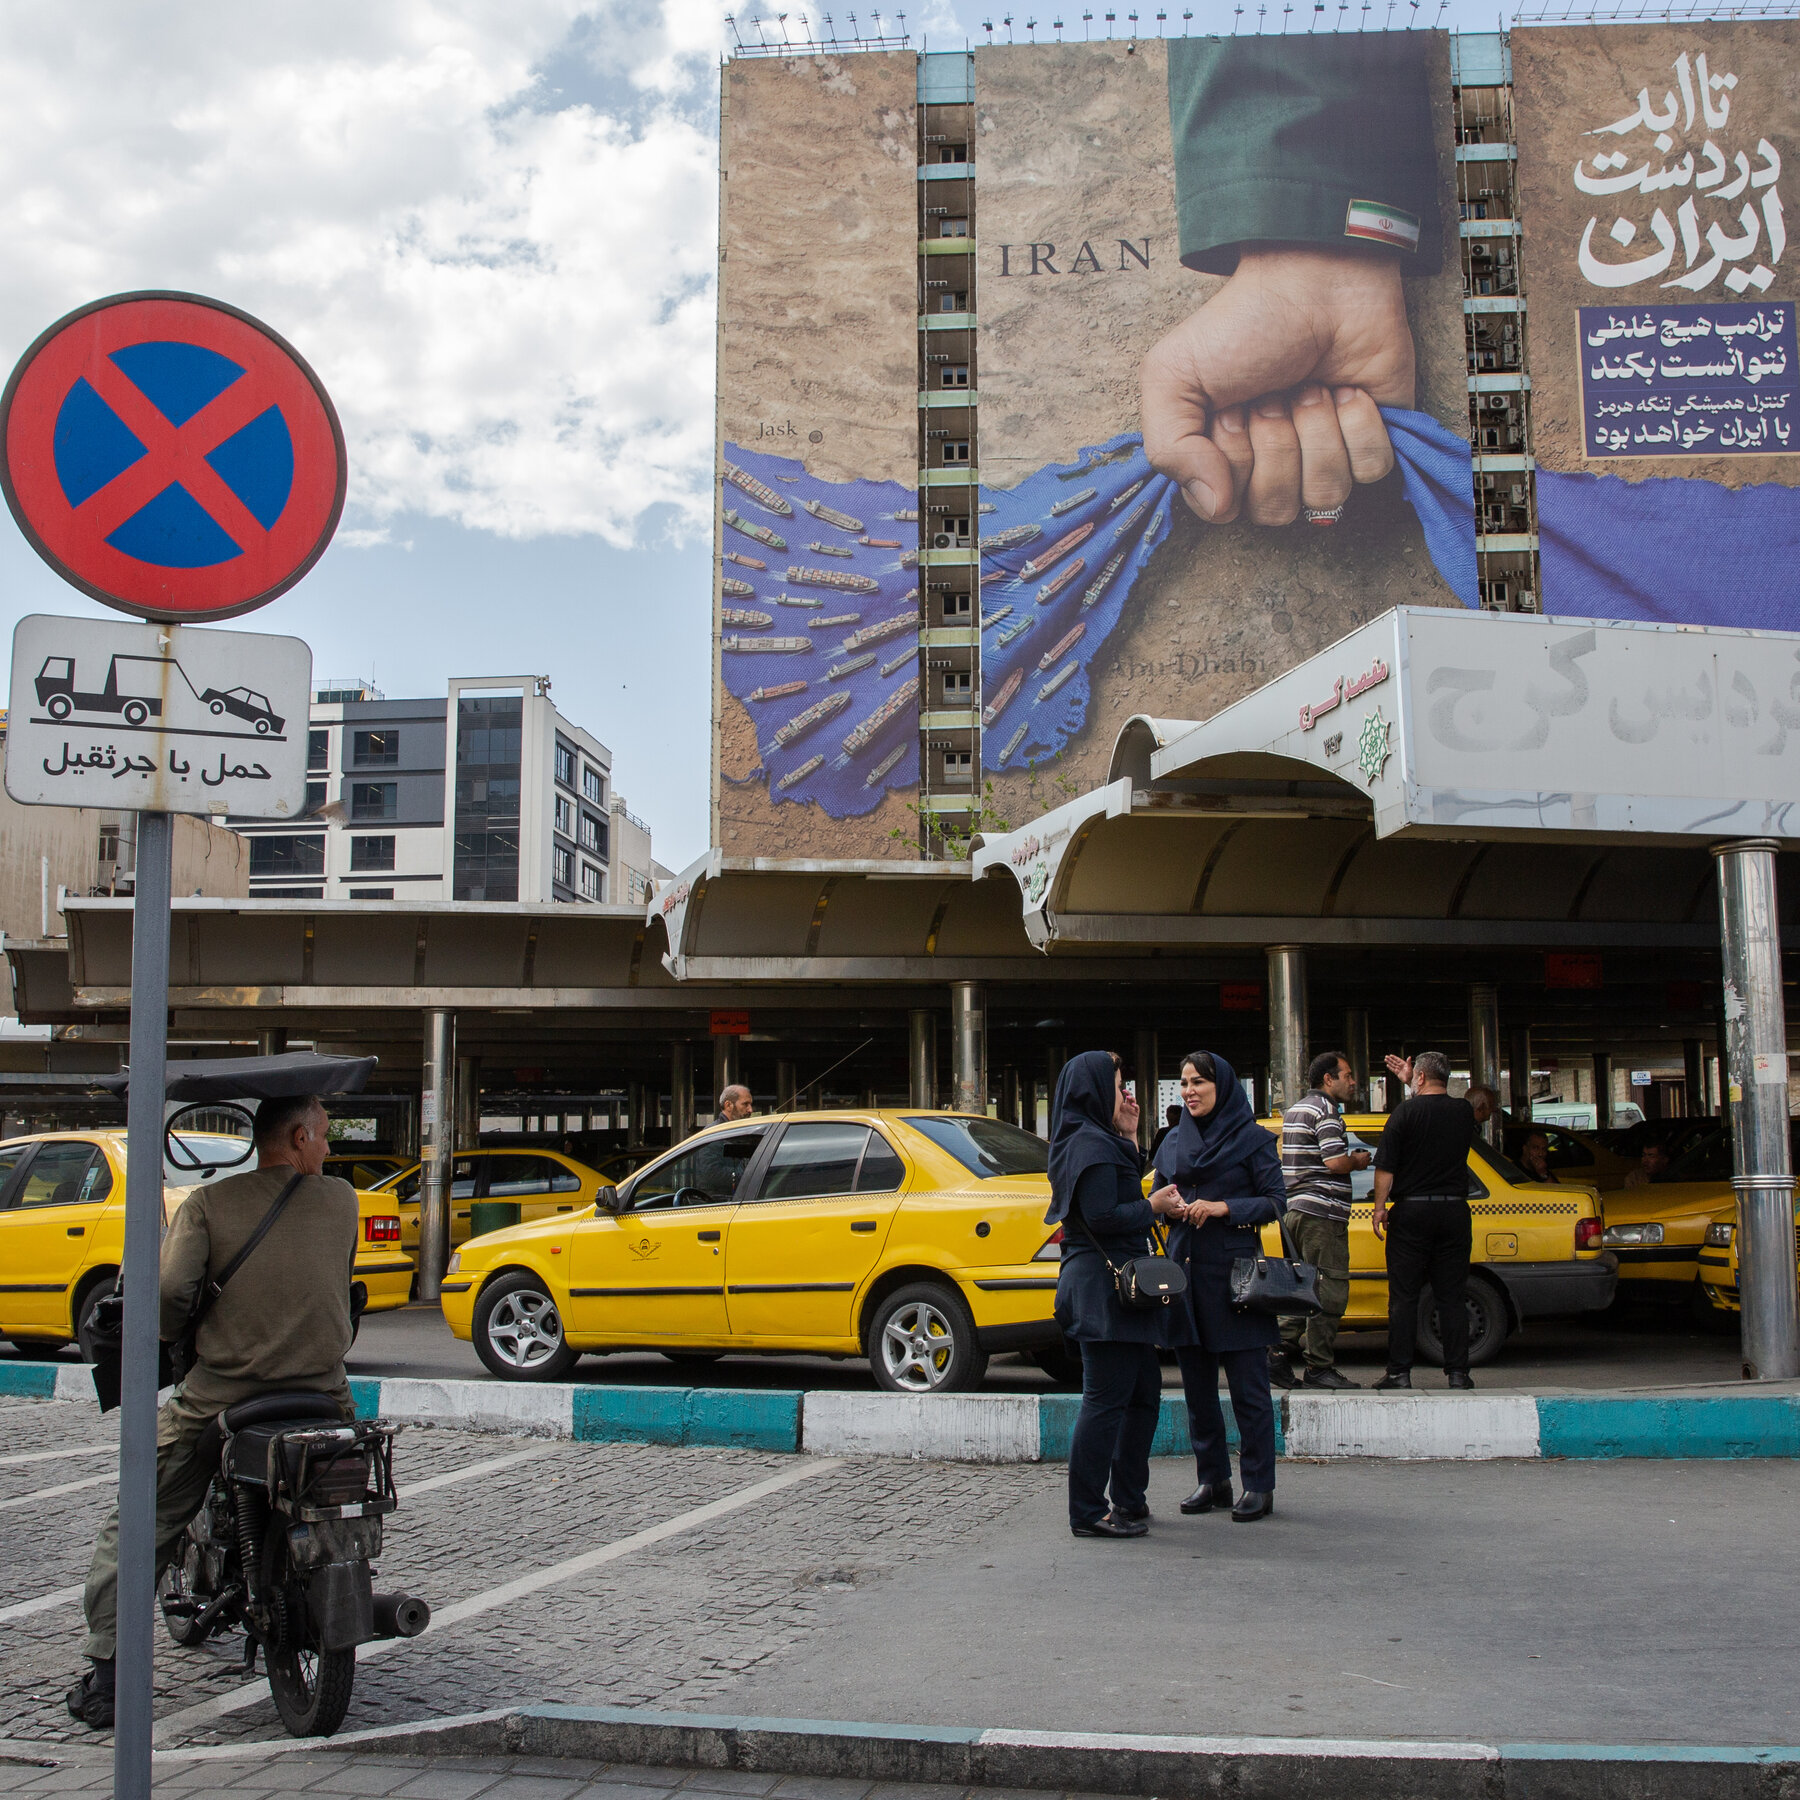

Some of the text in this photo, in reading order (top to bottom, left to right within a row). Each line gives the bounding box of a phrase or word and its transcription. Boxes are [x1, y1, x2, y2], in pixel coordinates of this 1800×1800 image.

[1581, 50, 1739, 155] تا ابد
[1574, 138, 1781, 200] در دست
[999, 237, 1151, 278] IRAN
[1577, 185, 1786, 294] ایران
[1587, 310, 1785, 347] ترامپ هیچ غلطی
[1590, 346, 1787, 386] نتوانست بکند
[1595, 394, 1790, 418] کنترل همیشگی تنگه هرمز
[755, 419, 798, 441] Jask
[1595, 416, 1791, 451] با ایران خواهد بود
[1299, 656, 1388, 732] مقصد کرج
[43, 742, 272, 786] حمل با جرثقیل
